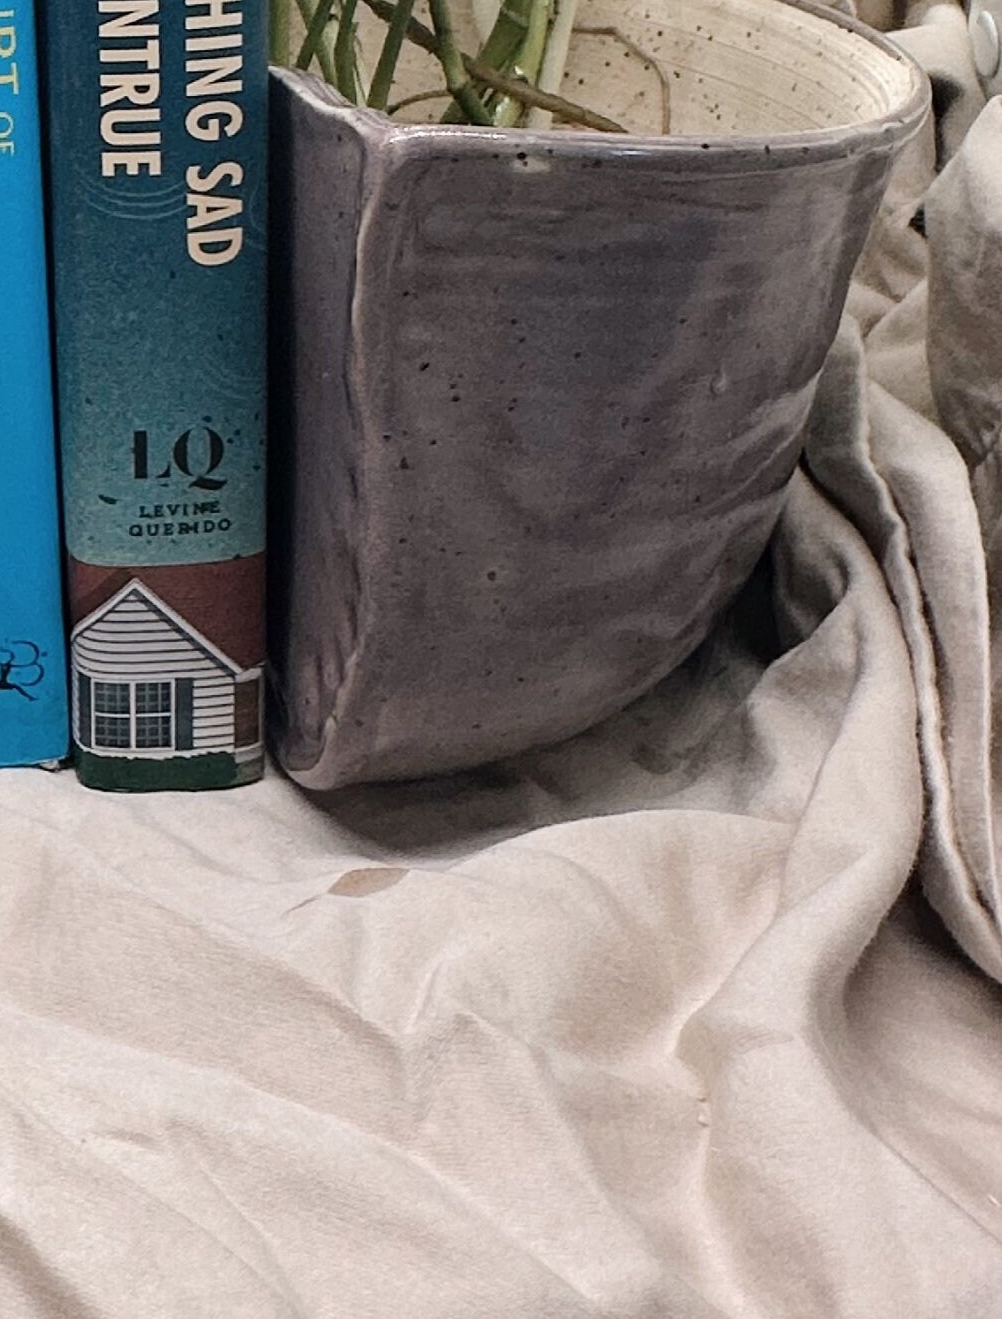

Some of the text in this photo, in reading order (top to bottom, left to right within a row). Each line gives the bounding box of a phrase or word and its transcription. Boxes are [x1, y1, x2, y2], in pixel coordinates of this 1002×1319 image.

[186, 159, 245, 268] SAD
[133, 426, 228, 490] LQ
[129, 518, 232, 537] QUERIDO
[139, 500, 221, 519] LEVINE
